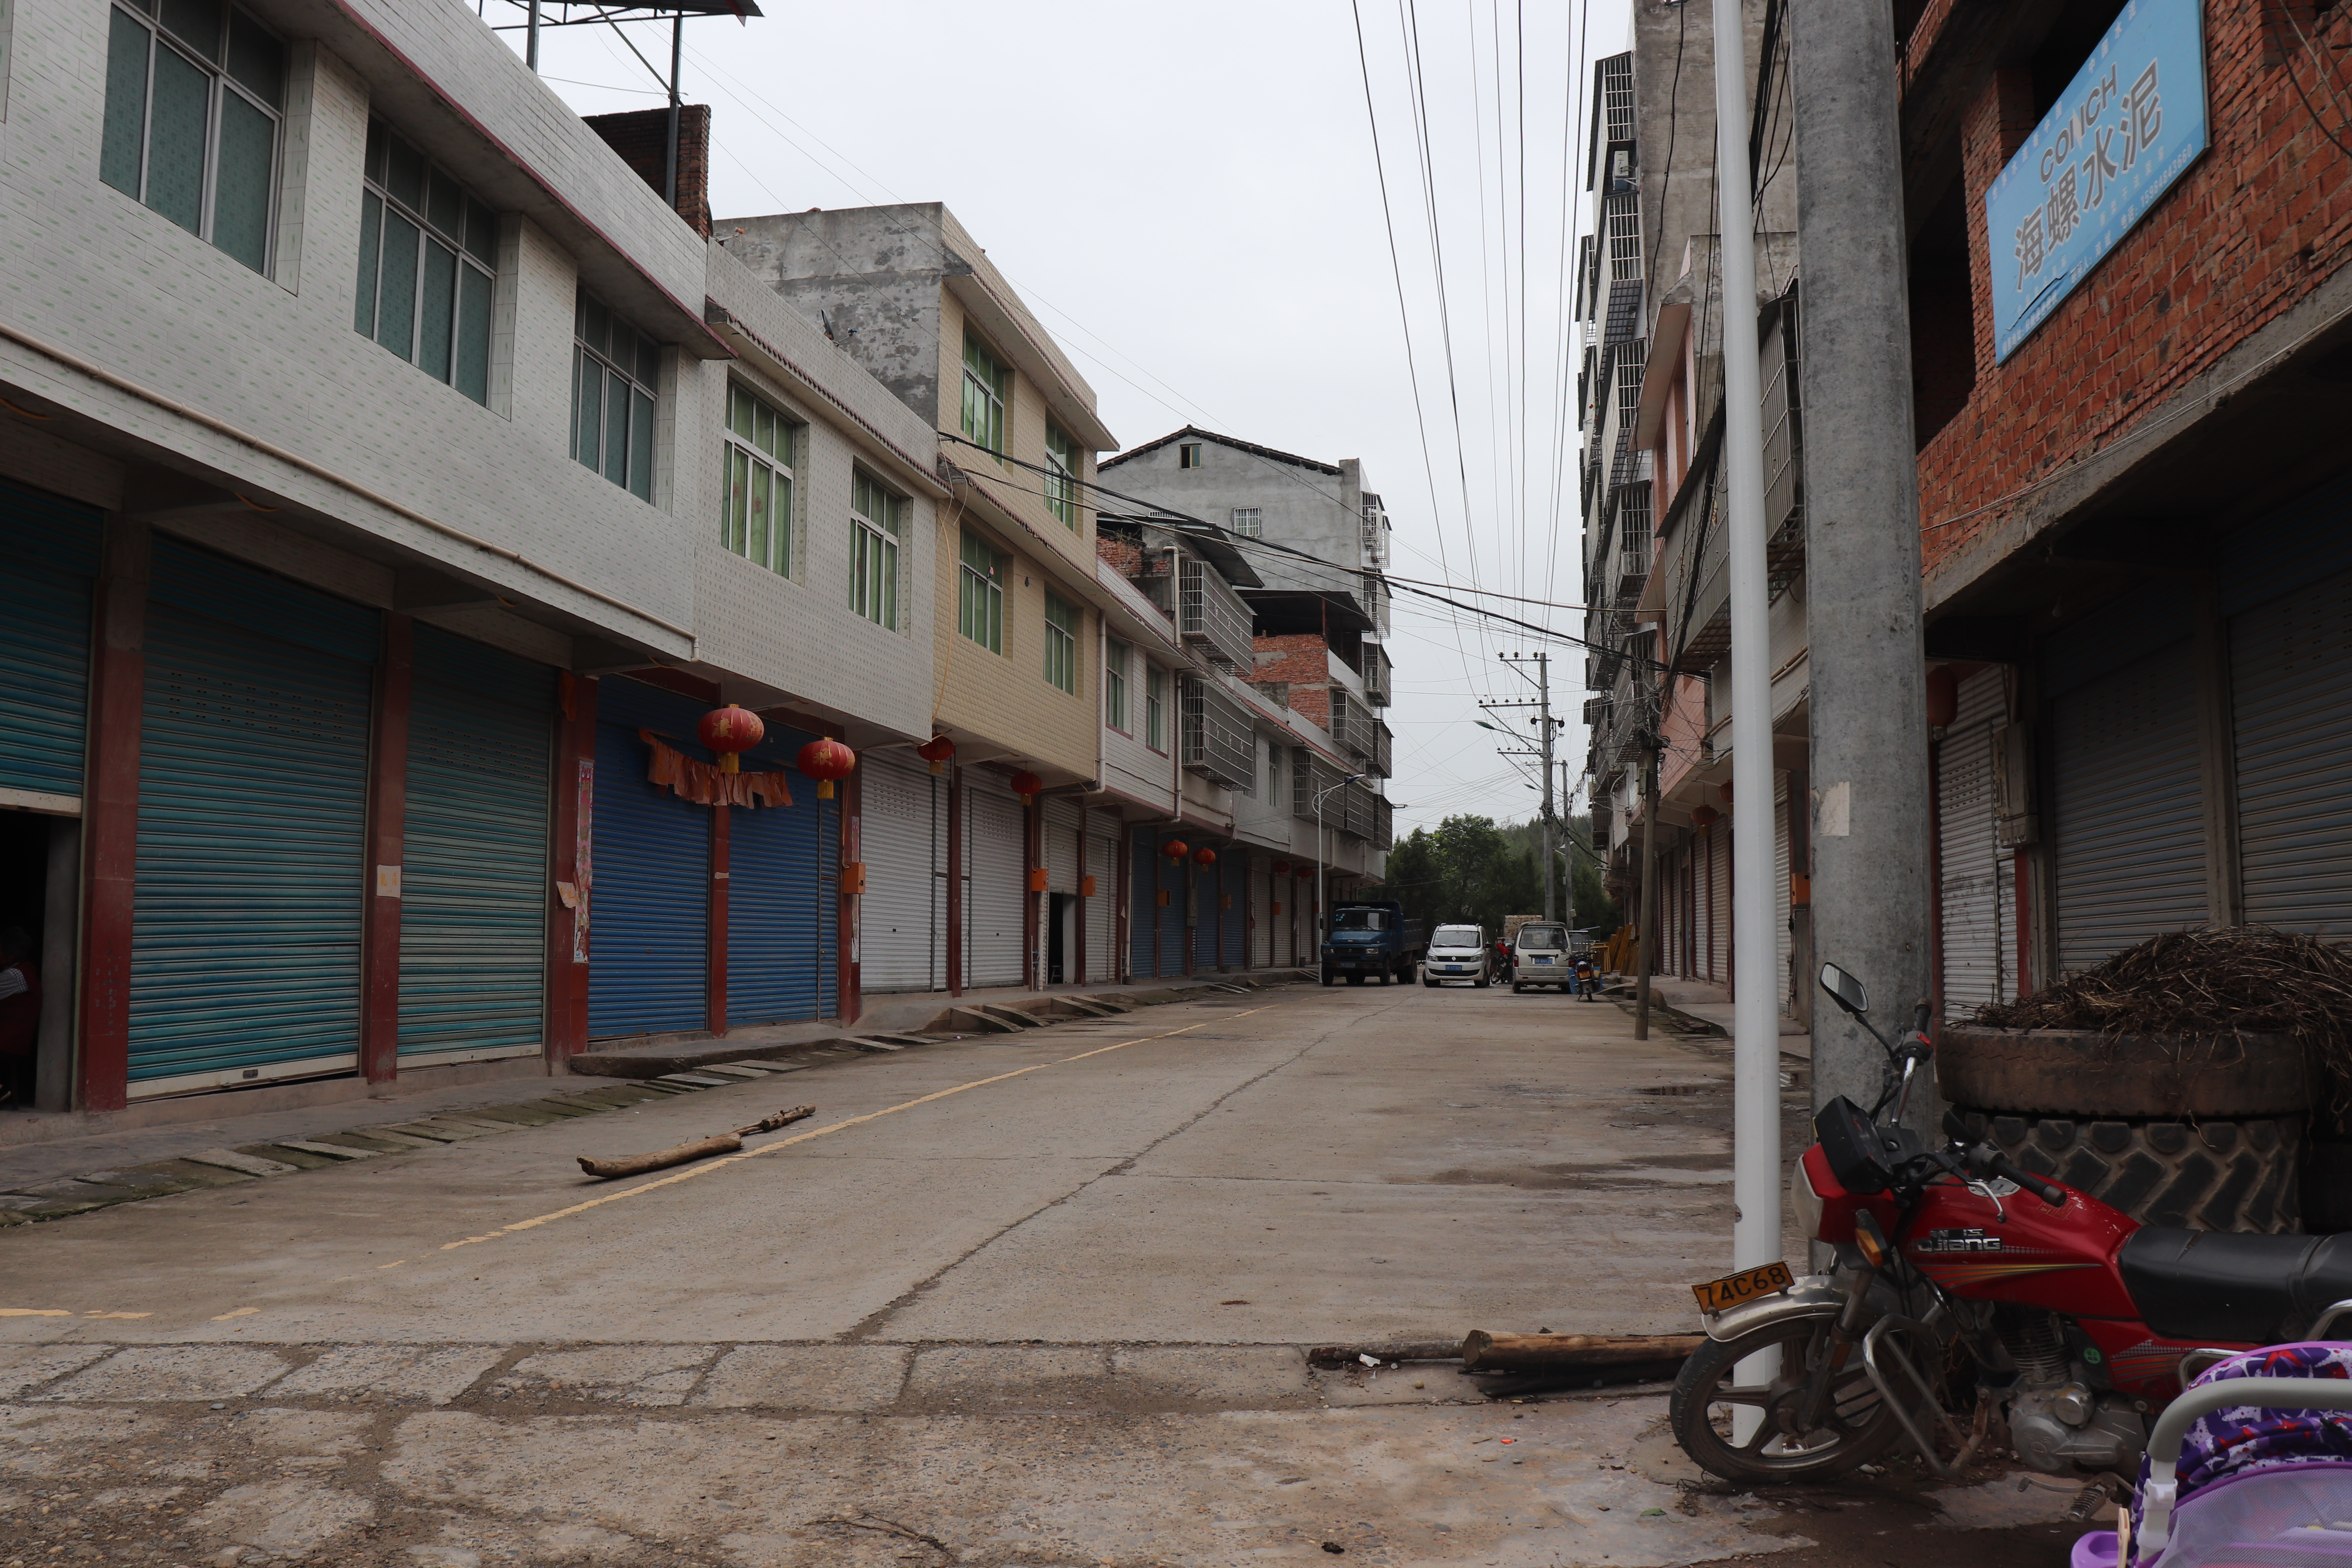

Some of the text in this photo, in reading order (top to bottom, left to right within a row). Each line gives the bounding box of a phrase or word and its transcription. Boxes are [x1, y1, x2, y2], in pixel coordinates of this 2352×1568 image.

[2015, 57, 2162, 292] 海螺水泥
[2041, 62, 2117, 184] CONCH
[1698, 1267, 1786, 1306] 74C68
